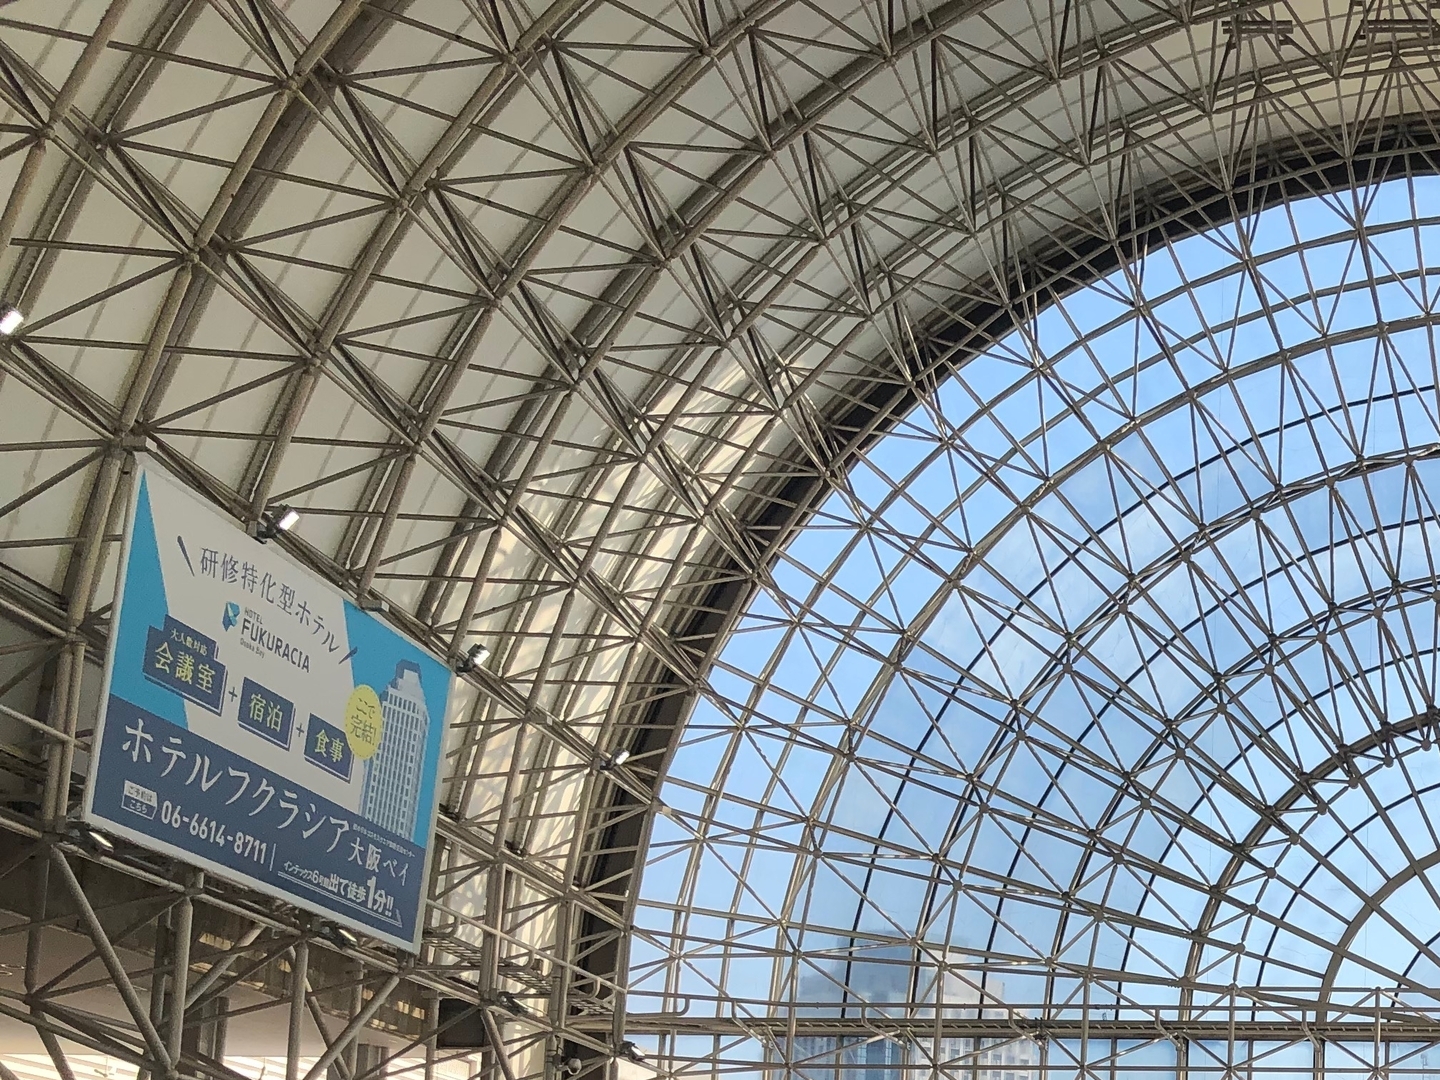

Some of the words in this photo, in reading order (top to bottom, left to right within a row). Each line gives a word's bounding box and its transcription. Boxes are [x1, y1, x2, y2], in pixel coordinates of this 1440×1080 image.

[200, 547, 340, 653] 研修特化型ホテル
[244, 606, 264, 625] HOTEL
[155, 641, 216, 694] 会議室
[241, 618, 310, 673] FUKURACIA
[249, 693, 283, 732] 宿泊
[314, 729, 344, 763] 食事
[129, 799, 148, 814] こちら
[161, 800, 267, 864] 06-6614-8711
